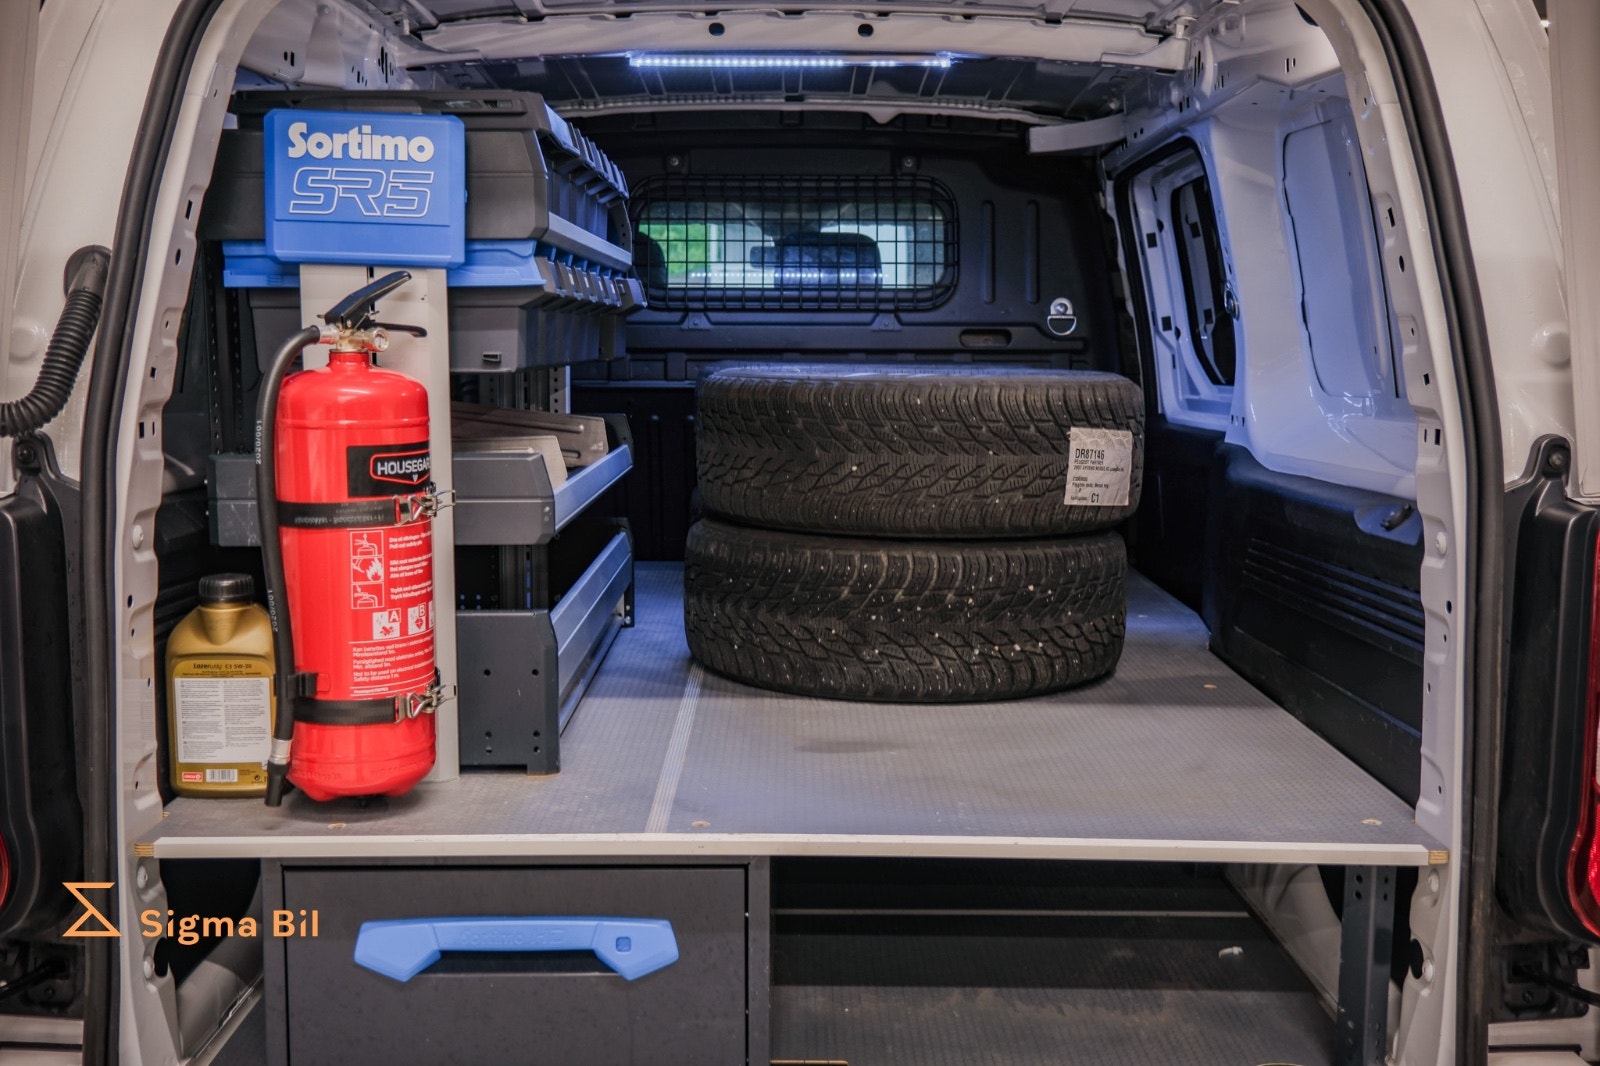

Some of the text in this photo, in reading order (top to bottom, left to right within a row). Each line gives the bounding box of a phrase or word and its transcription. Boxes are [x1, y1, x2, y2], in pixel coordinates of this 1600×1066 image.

[288, 122, 435, 162] Sortimo
[289, 166, 435, 218] SR5
[1075, 448, 1104, 460] DR87146
[1091, 493, 1100, 503] C1
[267, 590, 278, 632] 2020/001
[389, 610, 399, 622] A
[419, 604, 426, 617] B
